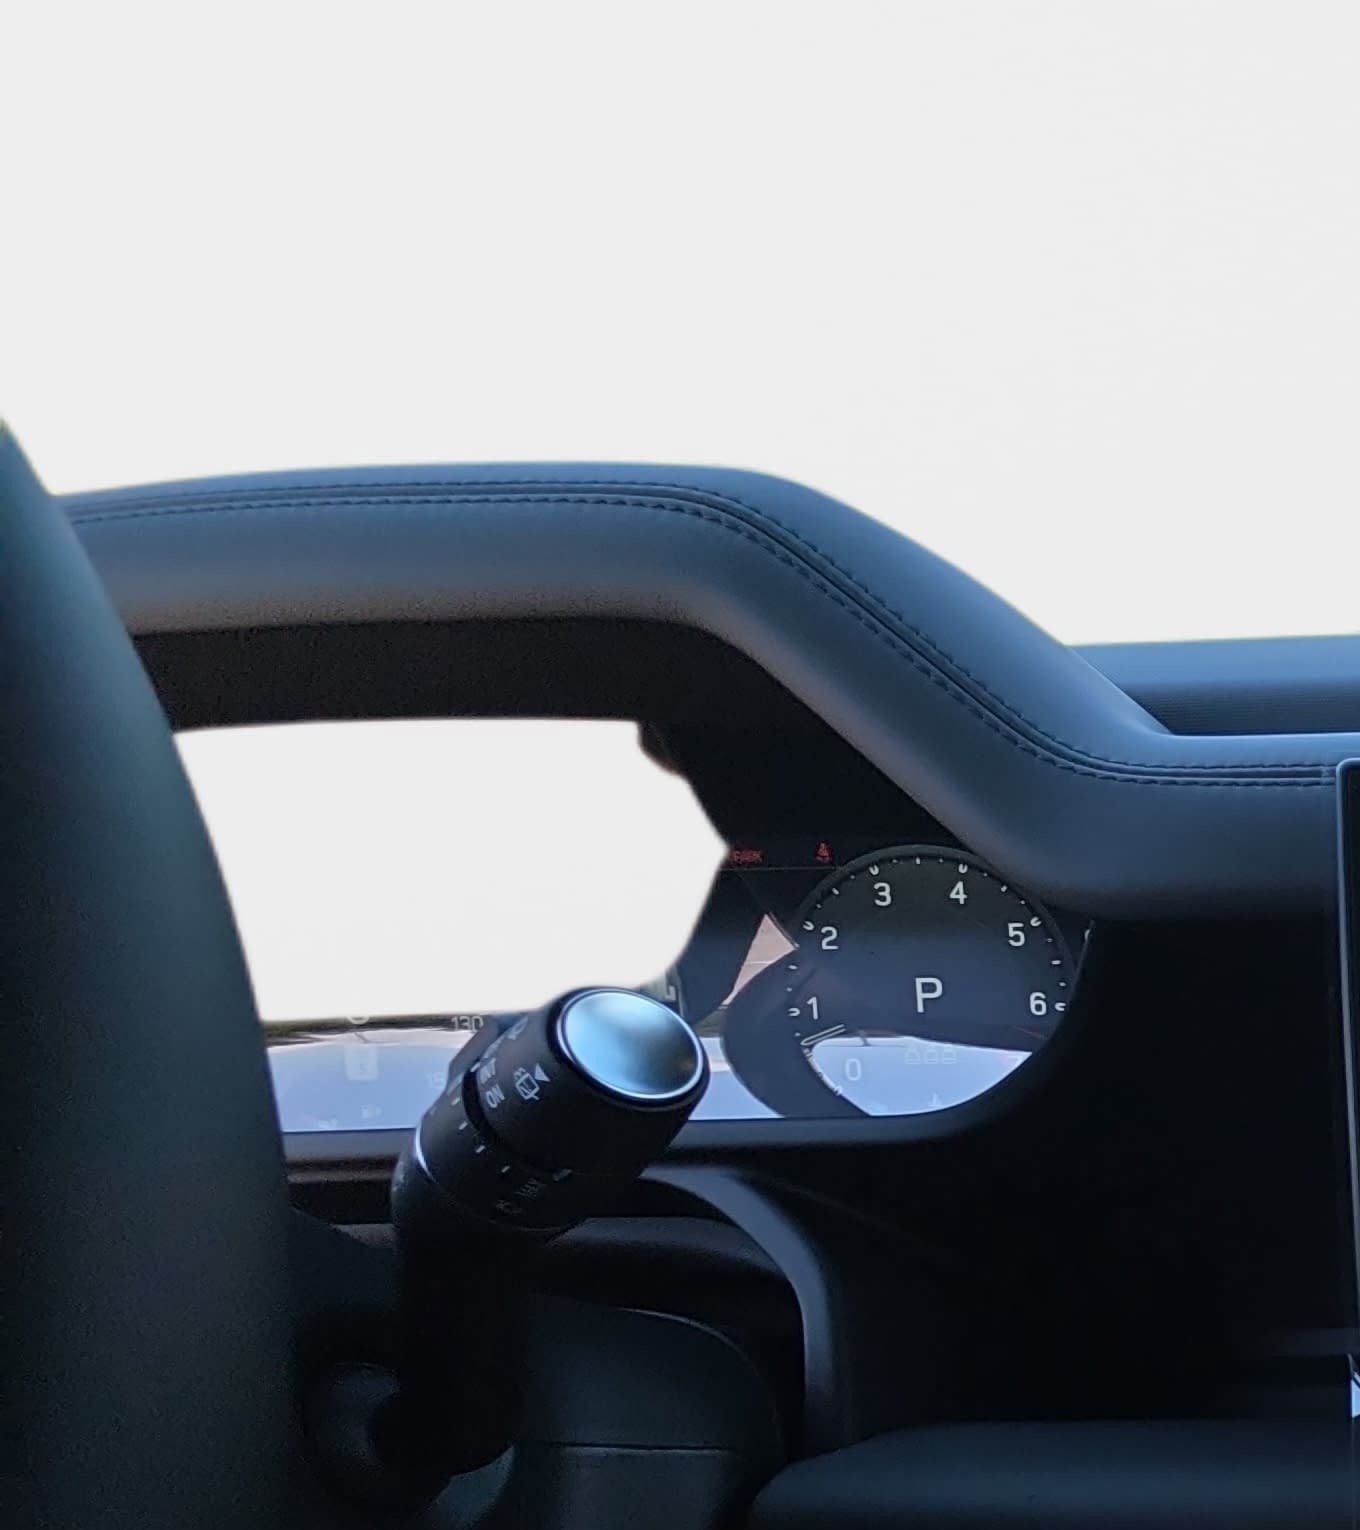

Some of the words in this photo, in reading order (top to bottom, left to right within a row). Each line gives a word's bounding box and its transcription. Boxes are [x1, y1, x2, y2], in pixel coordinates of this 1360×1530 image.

[874, 883, 893, 907] 3
[949, 882, 968, 905] 4
[820, 927, 840, 951] 2
[1007, 923, 1026, 947] 5
[914, 977, 943, 1013] P
[1028, 992, 1047, 1016] 6
[805, 996, 820, 1020] 1
